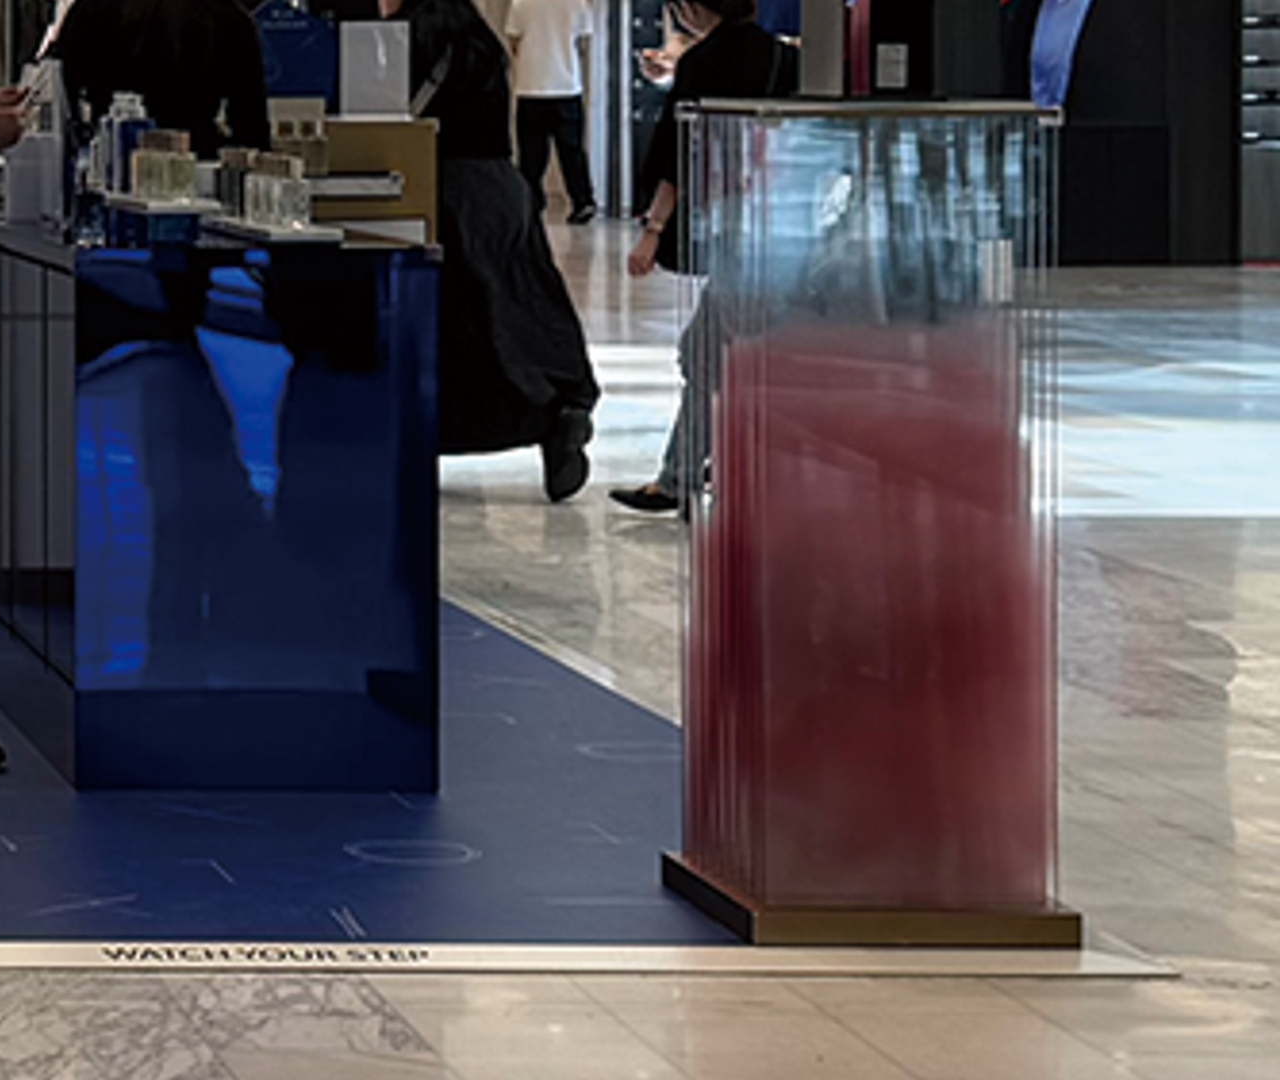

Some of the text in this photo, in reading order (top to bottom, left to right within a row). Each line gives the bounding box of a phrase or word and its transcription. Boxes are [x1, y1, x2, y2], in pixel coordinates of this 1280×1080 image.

[101, 946, 430, 962] WATCH YOUR STEP
